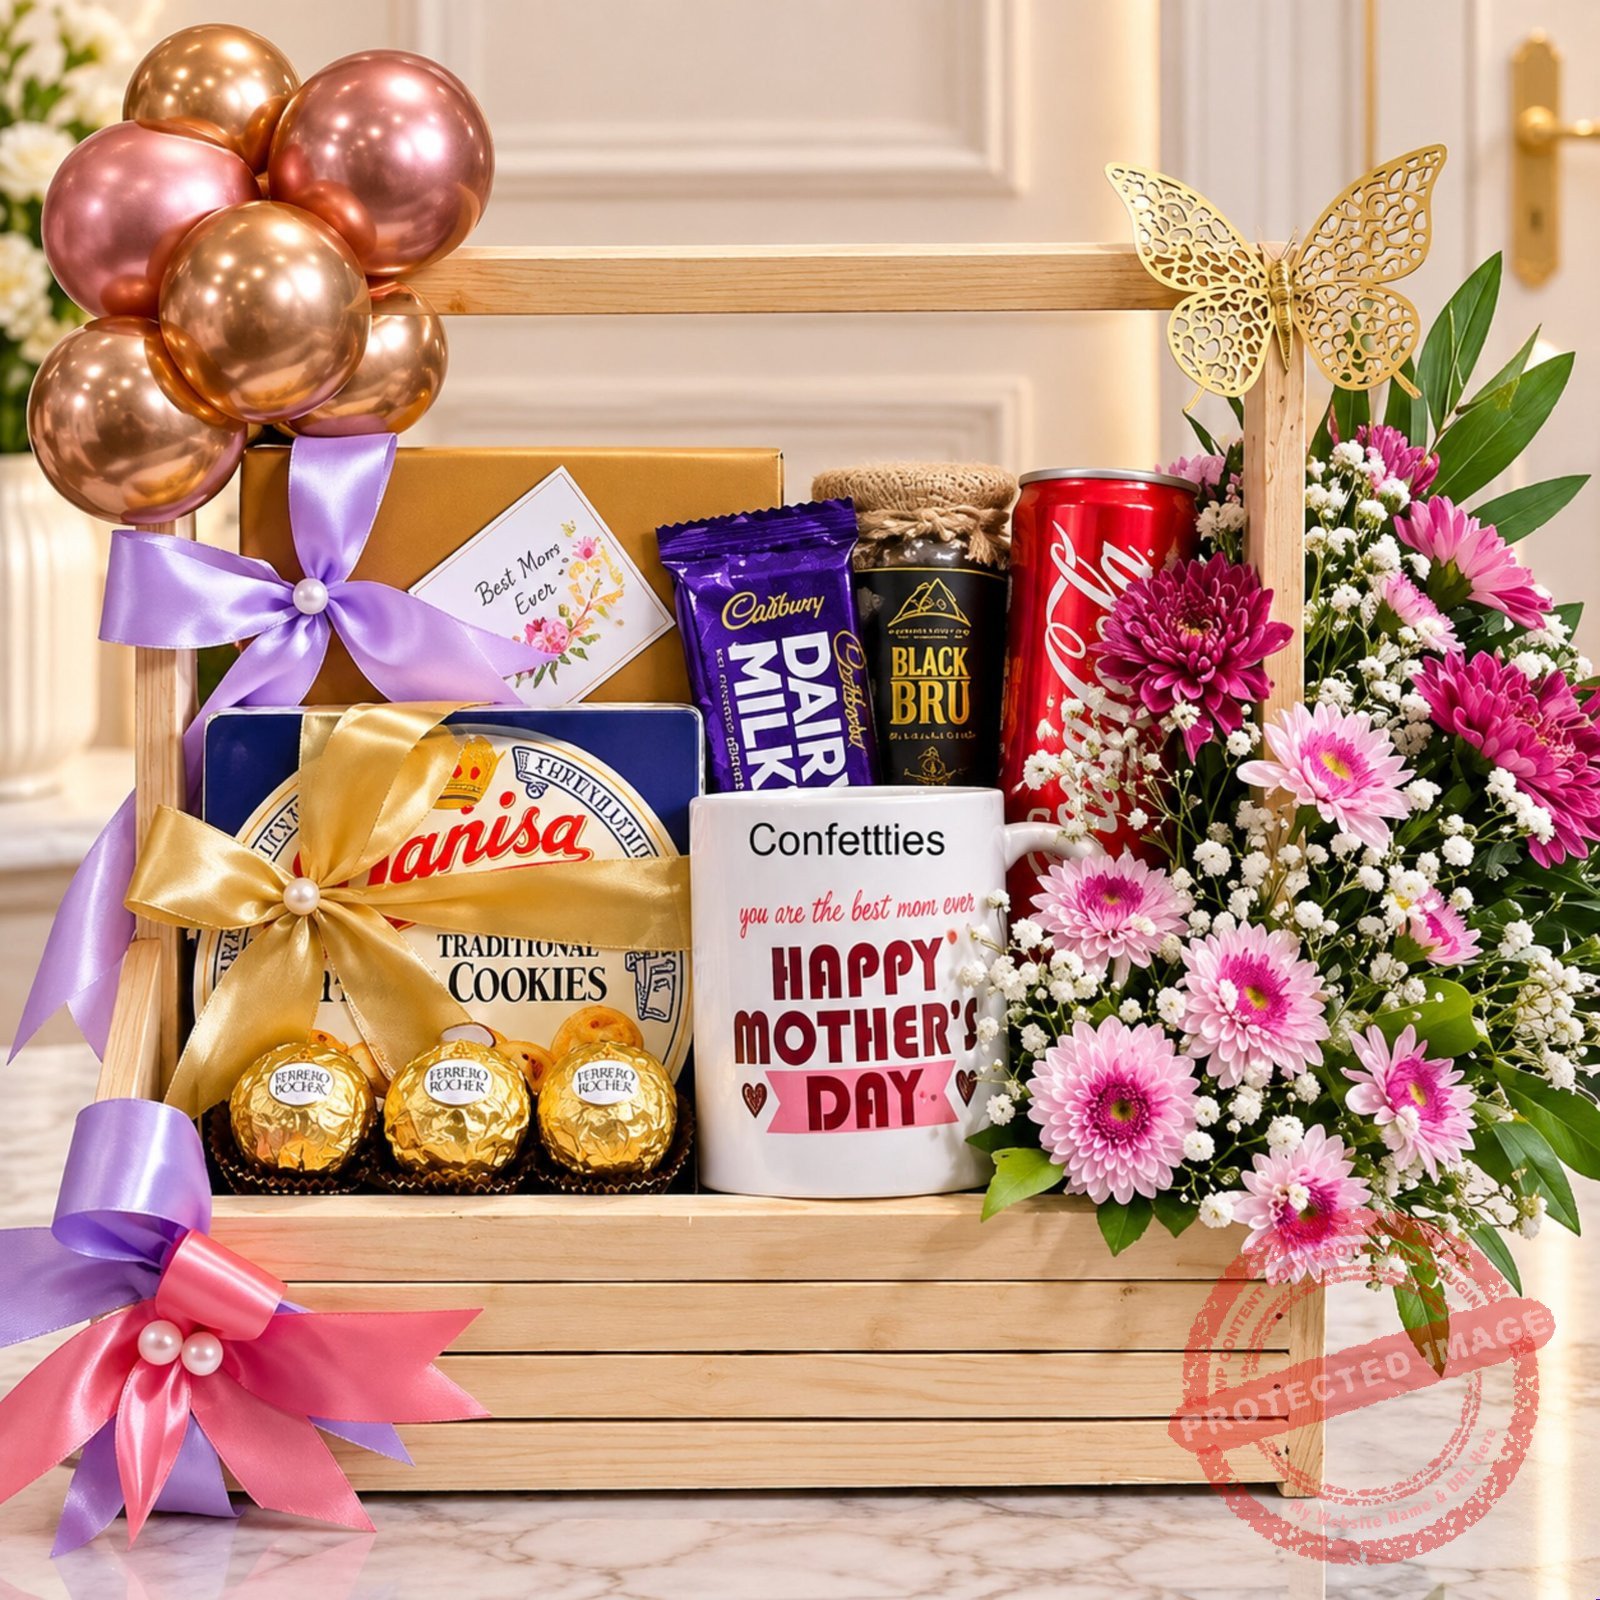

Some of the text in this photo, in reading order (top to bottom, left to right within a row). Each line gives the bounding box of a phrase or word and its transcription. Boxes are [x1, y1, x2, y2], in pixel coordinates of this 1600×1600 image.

[475, 568, 516, 606] Best
[515, 584, 557, 615] Ever
[721, 591, 825, 630] Cadbury
[891, 647, 968, 677] BLACK
[728, 640, 798, 791] MILK
[890, 681, 970, 725] BRU
[368, 791, 593, 885] anisa
[739, 889, 975, 939] you are the best mom ever
[436, 934, 599, 958] TRADITIONAL
[449, 961, 607, 1002] COOKIES
[771, 937, 943, 1000] HAPPY
[733, 997, 977, 1065] MOTHER'S
[429, 1066, 488, 1081] FERRERO
[429, 1079, 485, 1094] ROCHER
[577, 1067, 635, 1082] FERRERO
[806, 1068, 924, 1132] DAY
